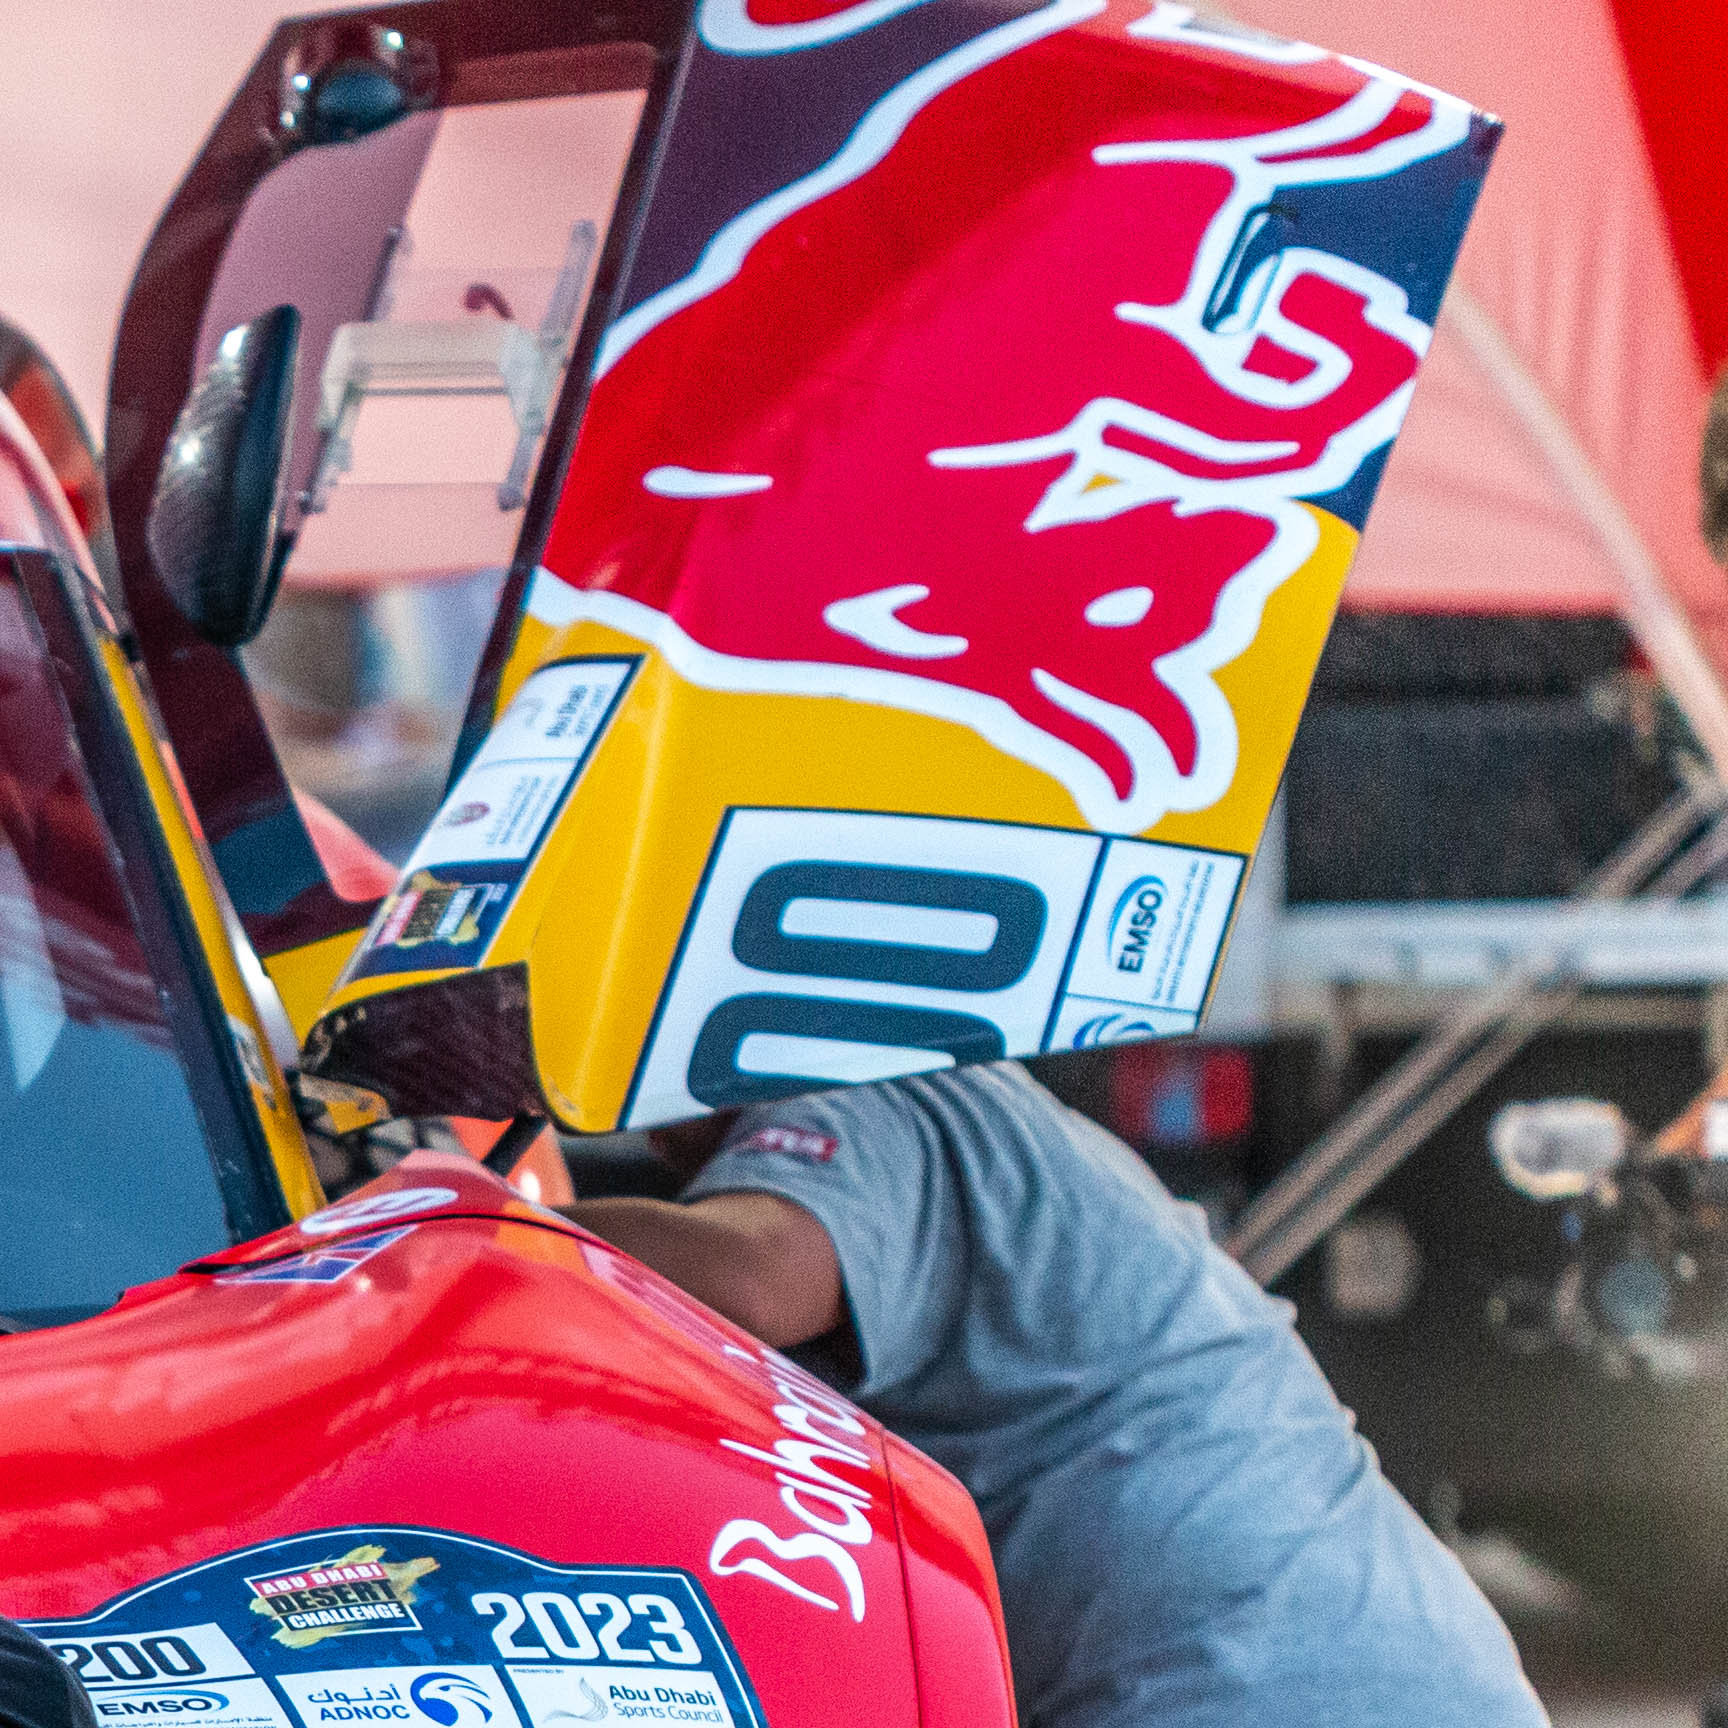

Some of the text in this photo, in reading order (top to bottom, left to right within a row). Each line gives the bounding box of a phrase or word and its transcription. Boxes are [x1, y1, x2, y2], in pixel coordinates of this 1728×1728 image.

[1117, 889, 1163, 973] EMSO
[687, 858, 1049, 1110] 00
[260, 1564, 383, 1595] ABU DHABI
[265, 1578, 398, 1615] DESERT
[288, 1603, 405, 1629] CHALLENGE
[471, 1591, 703, 1665] 2023
[48, 1636, 207, 1683] 200
[96, 1698, 213, 1716] EMSO
[609, 1684, 718, 1706] Abu Dhabi
[320, 1704, 411, 1721] ADNOC
[612, 1702, 725, 1724] Sports Council
